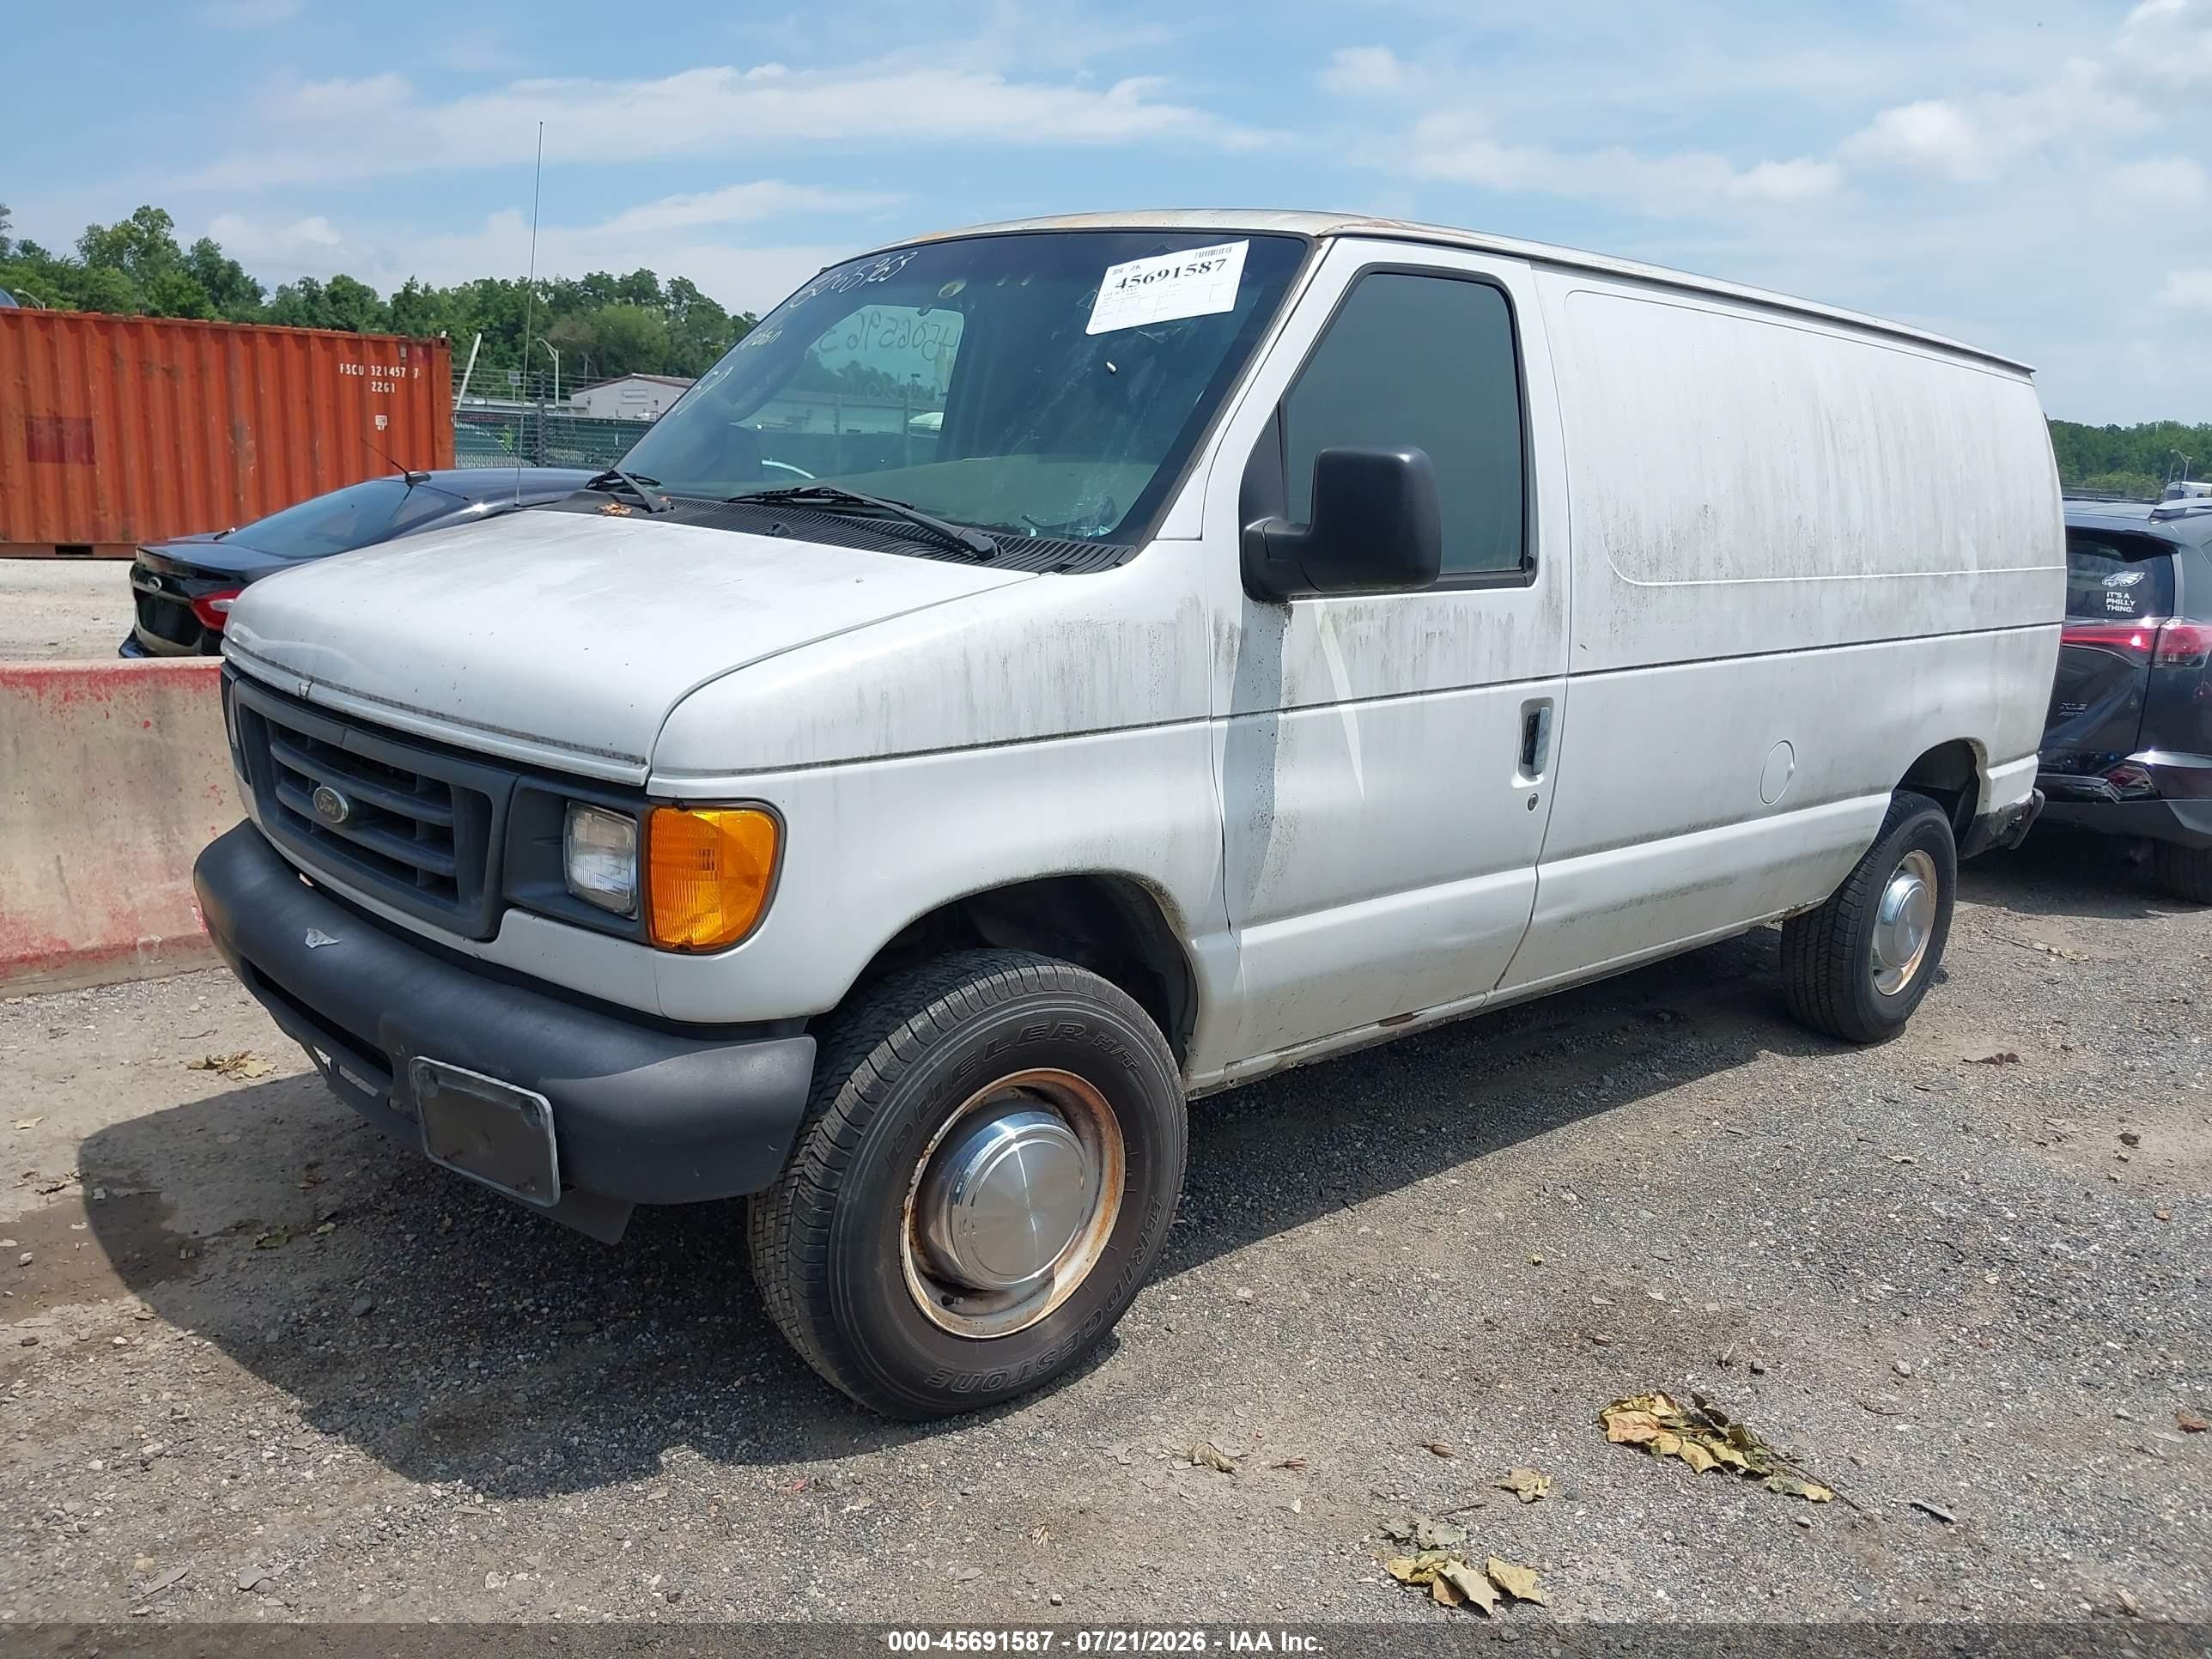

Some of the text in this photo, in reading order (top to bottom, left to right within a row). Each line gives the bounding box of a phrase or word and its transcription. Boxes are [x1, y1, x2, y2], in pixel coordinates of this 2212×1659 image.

[1115, 258, 1228, 291] 45691587
[370, 365, 406, 378] 321457
[371, 380, 396, 393] 22G1
[2106, 598, 2136, 606] PHILLY
[2106, 605, 2135, 613] THING.
[887, 1020, 1085, 1170] DUELER
[924, 1194, 1163, 1394] BRIDGESTONE
